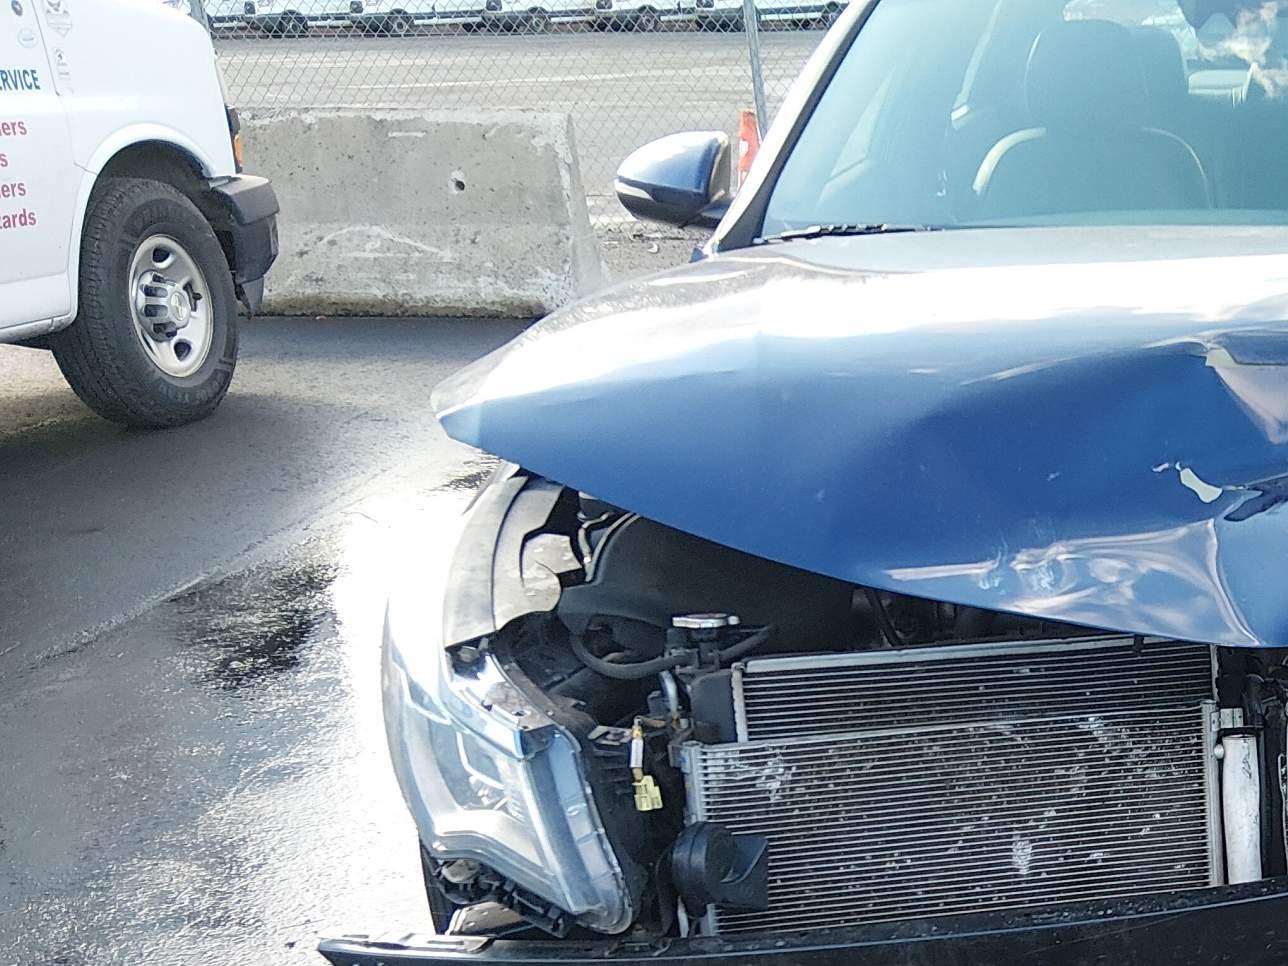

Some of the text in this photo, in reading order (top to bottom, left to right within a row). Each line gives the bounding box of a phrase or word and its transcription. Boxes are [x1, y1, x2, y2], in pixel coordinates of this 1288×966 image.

[0, 69, 41, 90] RVICE
[0, 121, 27, 136] ers
[0, 182, 26, 198] ers
[0, 208, 37, 229] ards
